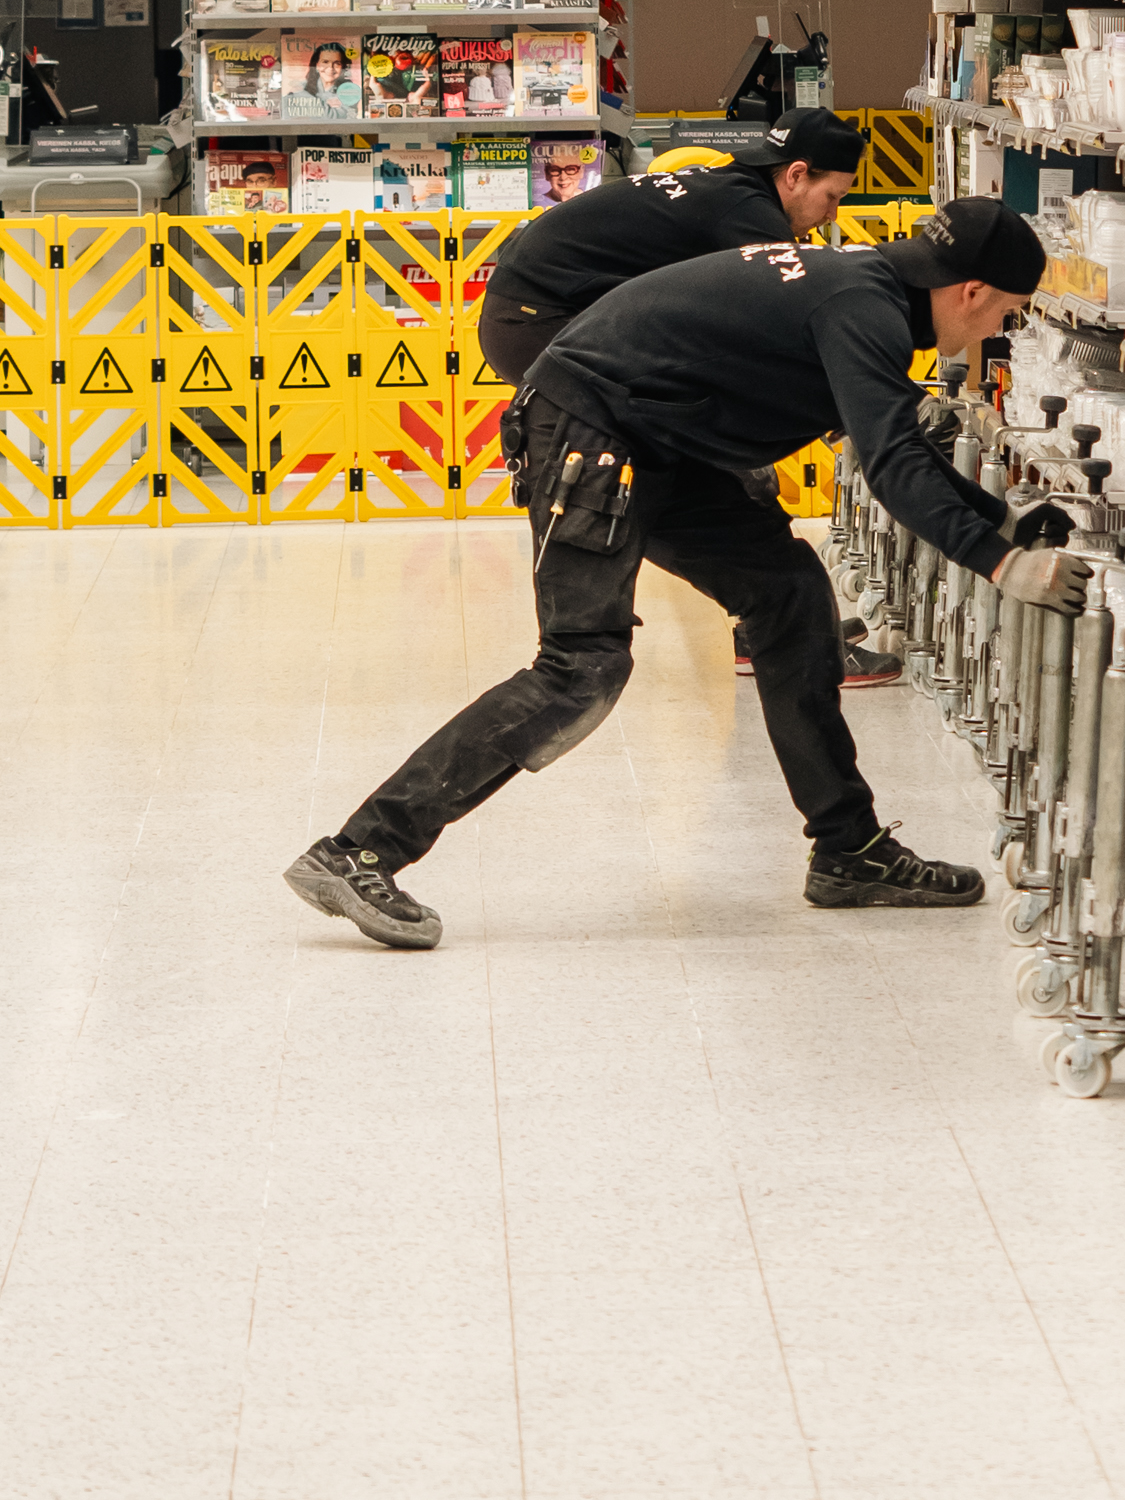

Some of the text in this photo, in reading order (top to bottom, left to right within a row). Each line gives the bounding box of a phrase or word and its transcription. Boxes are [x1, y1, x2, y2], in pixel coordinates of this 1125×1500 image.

[366, 35, 436, 56] Viljelyn
[714, 131, 740, 139] KASSA,
[305, 149, 372, 163] POP-RISTIKOT
[480, 149, 528, 161] HELPPO
[380, 163, 448, 177] kreikka
